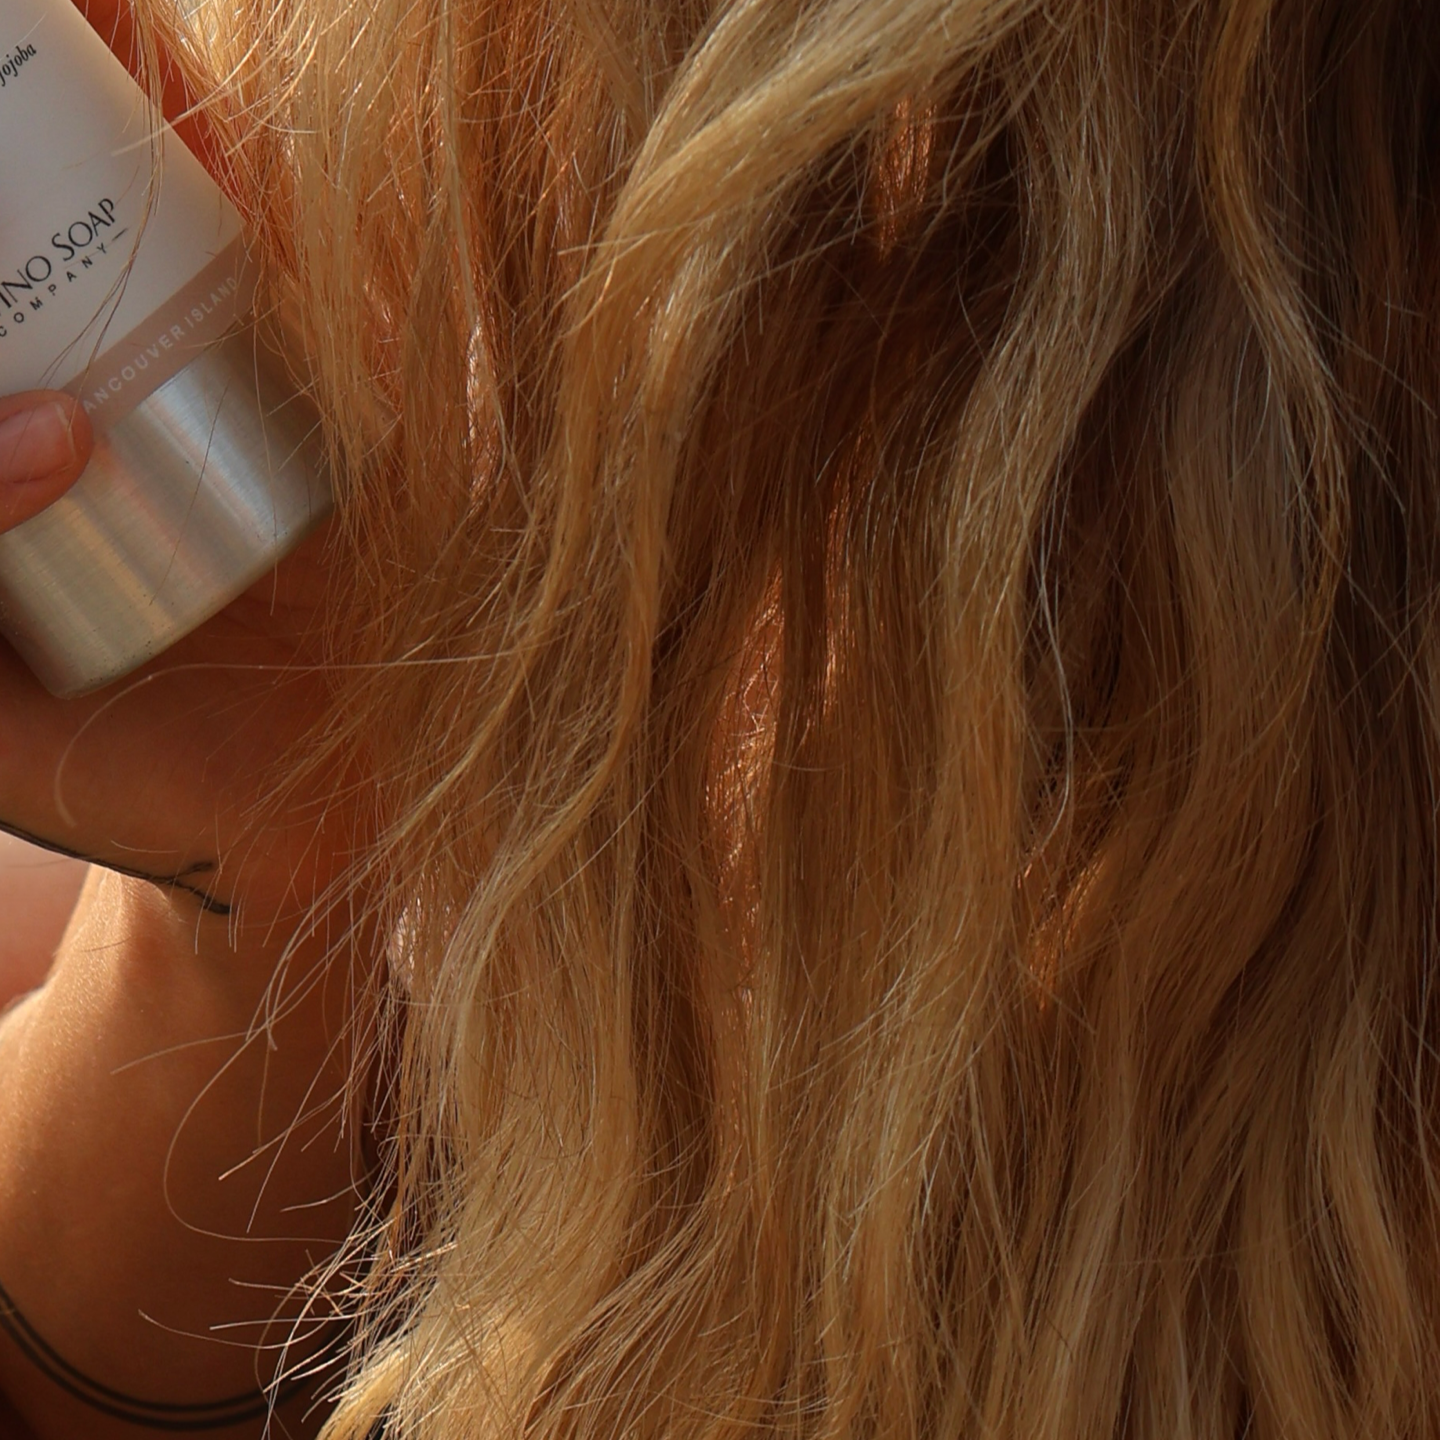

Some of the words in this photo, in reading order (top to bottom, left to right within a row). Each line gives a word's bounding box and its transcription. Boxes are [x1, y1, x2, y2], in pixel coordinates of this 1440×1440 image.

[51, 197, 116, 262] SOAP
[82, 324, 185, 414] ANCOUVER
[184, 276, 237, 328] ISLAND
